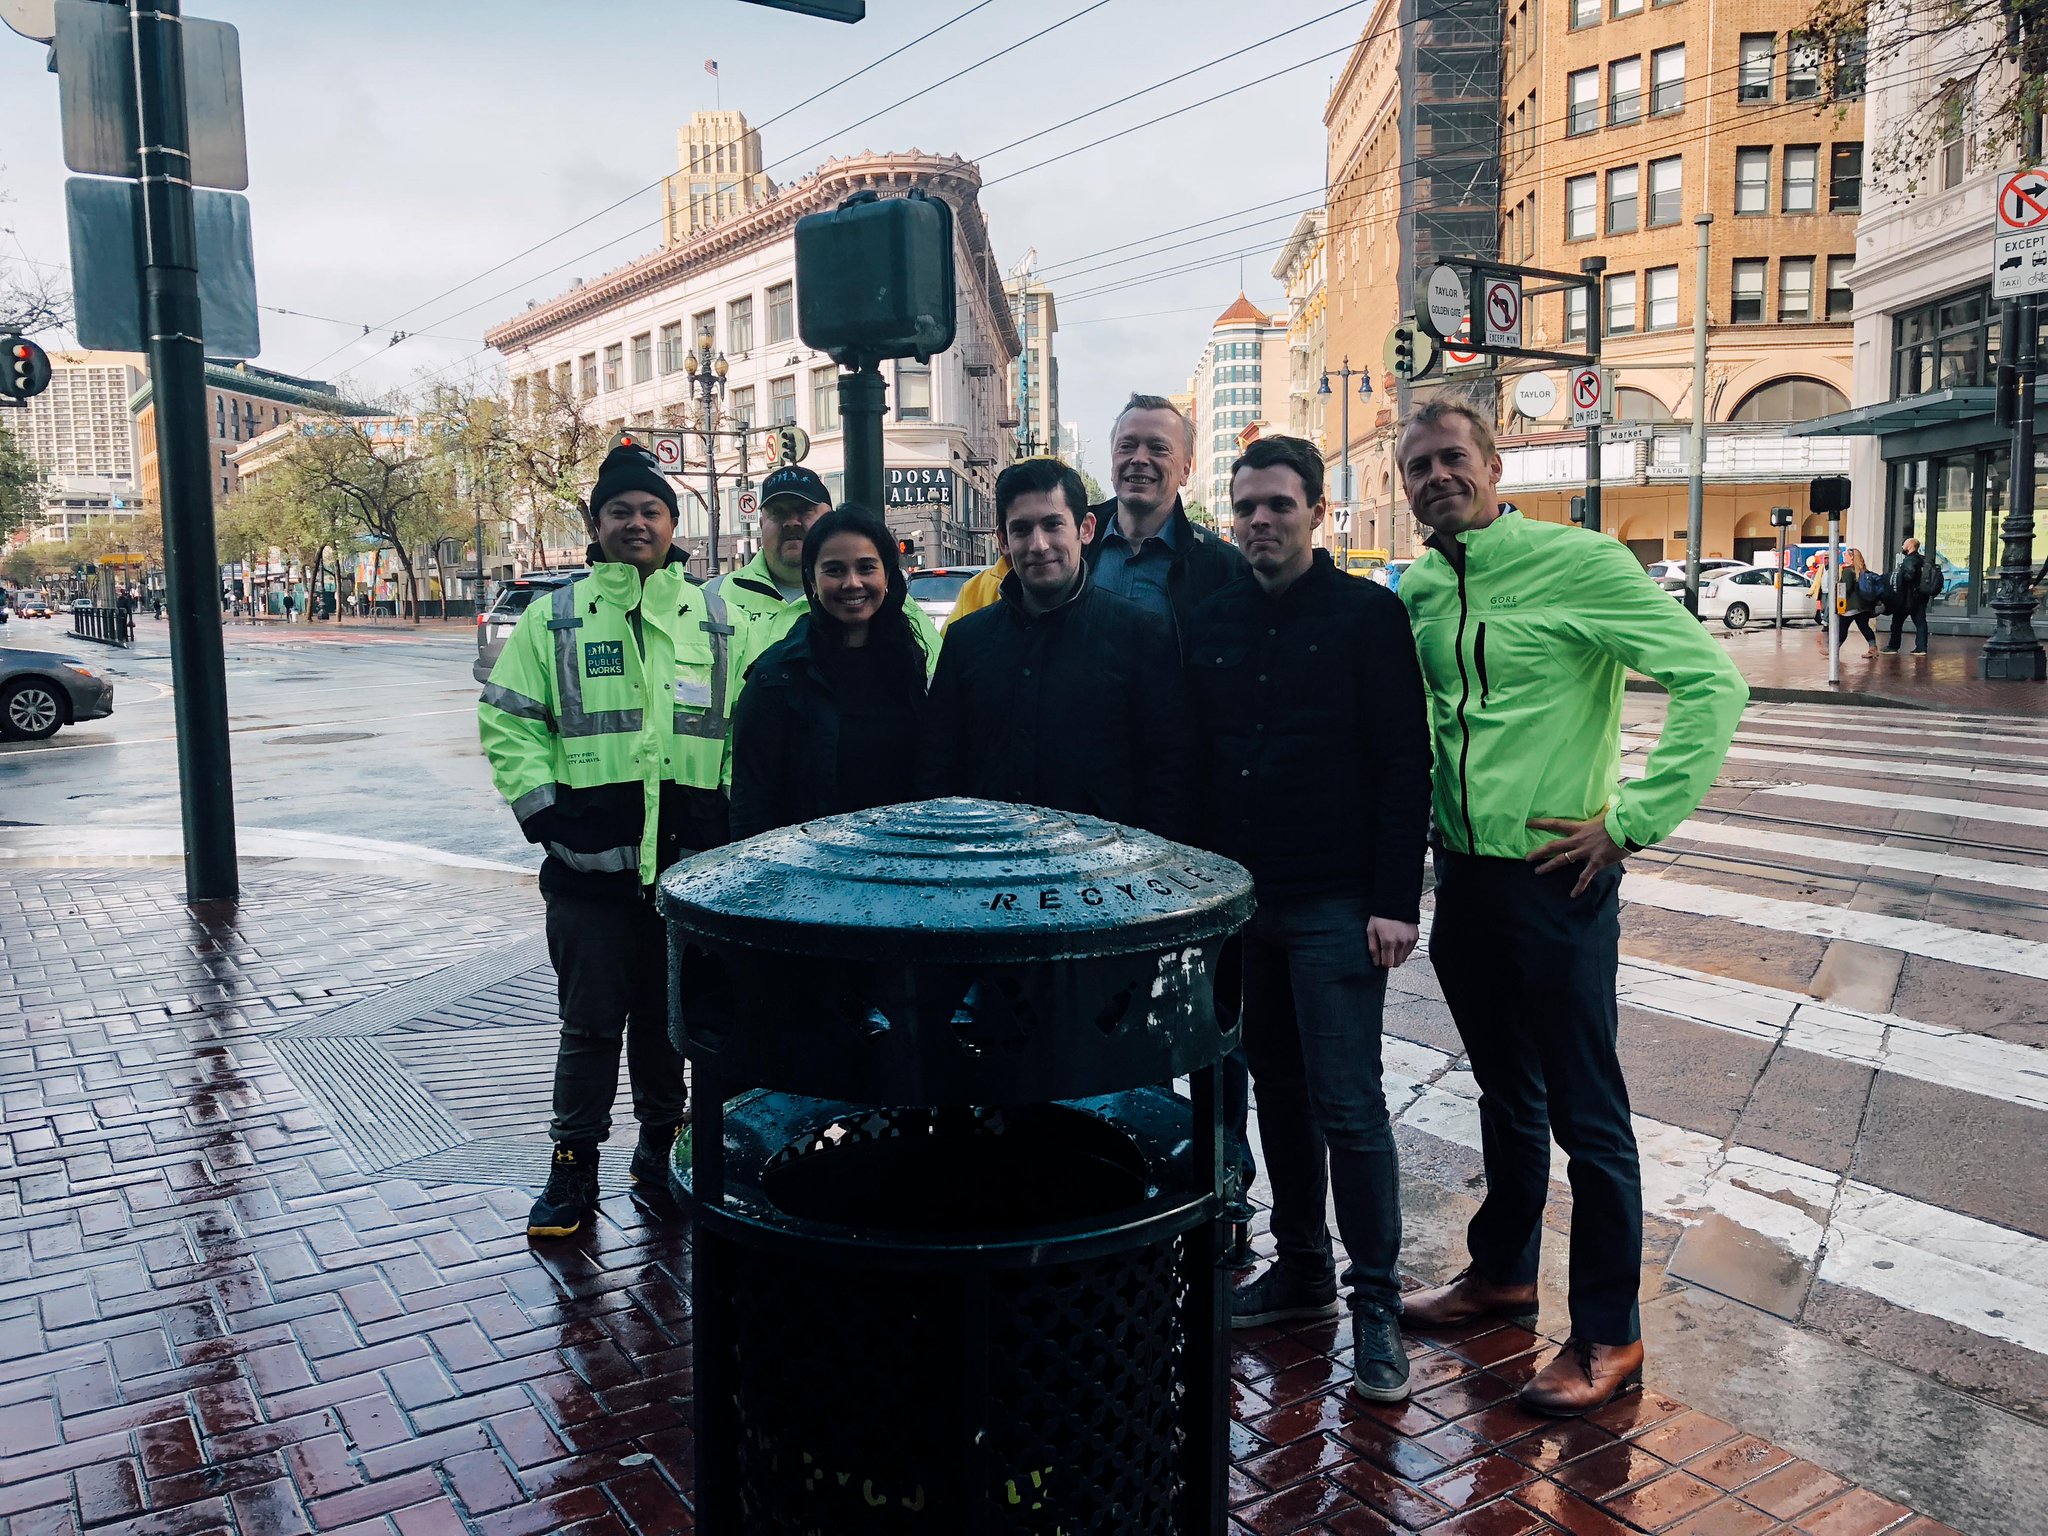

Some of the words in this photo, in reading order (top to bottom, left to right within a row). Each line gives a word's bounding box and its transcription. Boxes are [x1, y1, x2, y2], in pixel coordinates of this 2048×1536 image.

[2005, 236, 2045, 252] EXCEPT
[1435, 286, 1458, 298] TAYLOR
[1432, 304, 1450, 316] GOLDEN
[1450, 306, 1461, 318] GATE
[1520, 390, 1551, 399] TAYLOR
[1576, 412, 1584, 422] ON
[1586, 410, 1598, 420] RED
[1610, 429, 1643, 440] Market
[891, 469, 947, 484] DOSA
[1490, 595, 1517, 604] GORE
[588, 658, 621, 667] PUBLIC
[588, 666, 622, 675] WORKS
[989, 866, 1215, 911] RECYCLE
